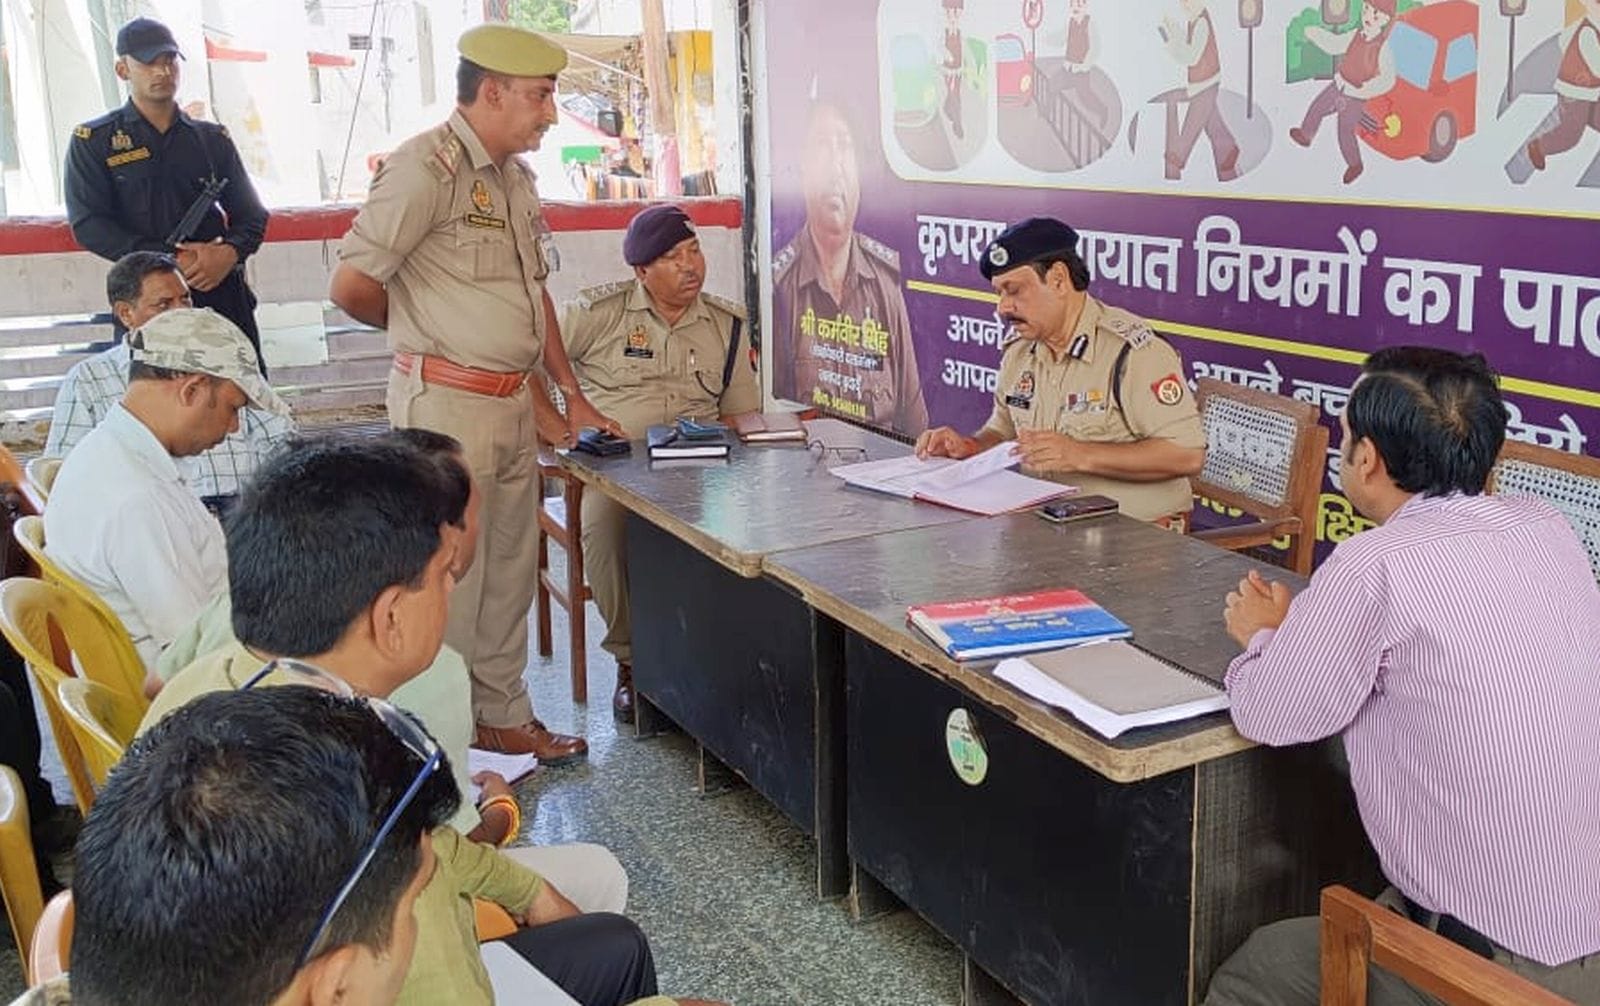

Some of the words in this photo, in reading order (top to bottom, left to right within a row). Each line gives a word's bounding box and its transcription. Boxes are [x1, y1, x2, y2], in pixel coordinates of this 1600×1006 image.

[916, 214, 1007, 276] कृपय
[1193, 214, 1379, 317] नियमों
[1382, 257, 1483, 333] का
[946, 312, 1005, 350] अपने
